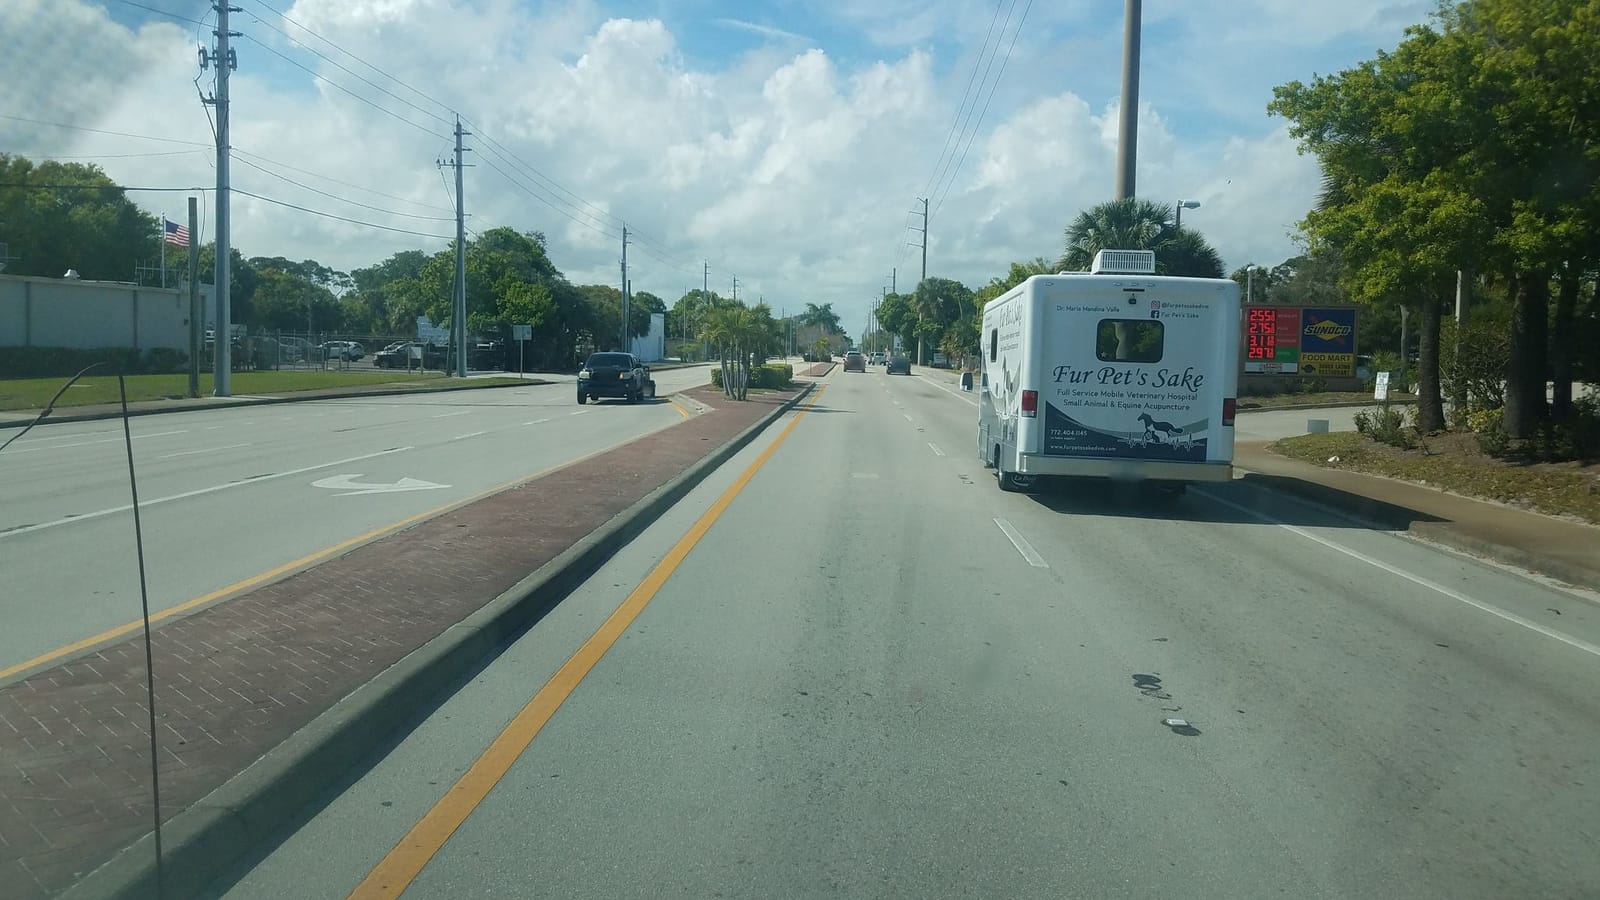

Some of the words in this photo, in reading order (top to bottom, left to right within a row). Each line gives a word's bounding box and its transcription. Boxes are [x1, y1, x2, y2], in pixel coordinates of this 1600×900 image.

[1305, 325, 1351, 335] SUNOCO
[1053, 365, 1093, 384] Fur
[1097, 366, 1148, 386] Pet's
[1152, 367, 1204, 393] Sake
[1057, 388, 1070, 396] Full
[1072, 389, 1098, 397] Service
[1100, 390, 1124, 398] Mobile
[1126, 391, 1165, 401] Veterinary
[1167, 392, 1198, 402] Hospital
[1063, 399, 1082, 407] Small
[1084, 400, 1108, 408] Animal
[1111, 400, 1115, 408] &
[1117, 401, 1142, 410] Equine
[1144, 402, 1191, 411] Acupuncture
